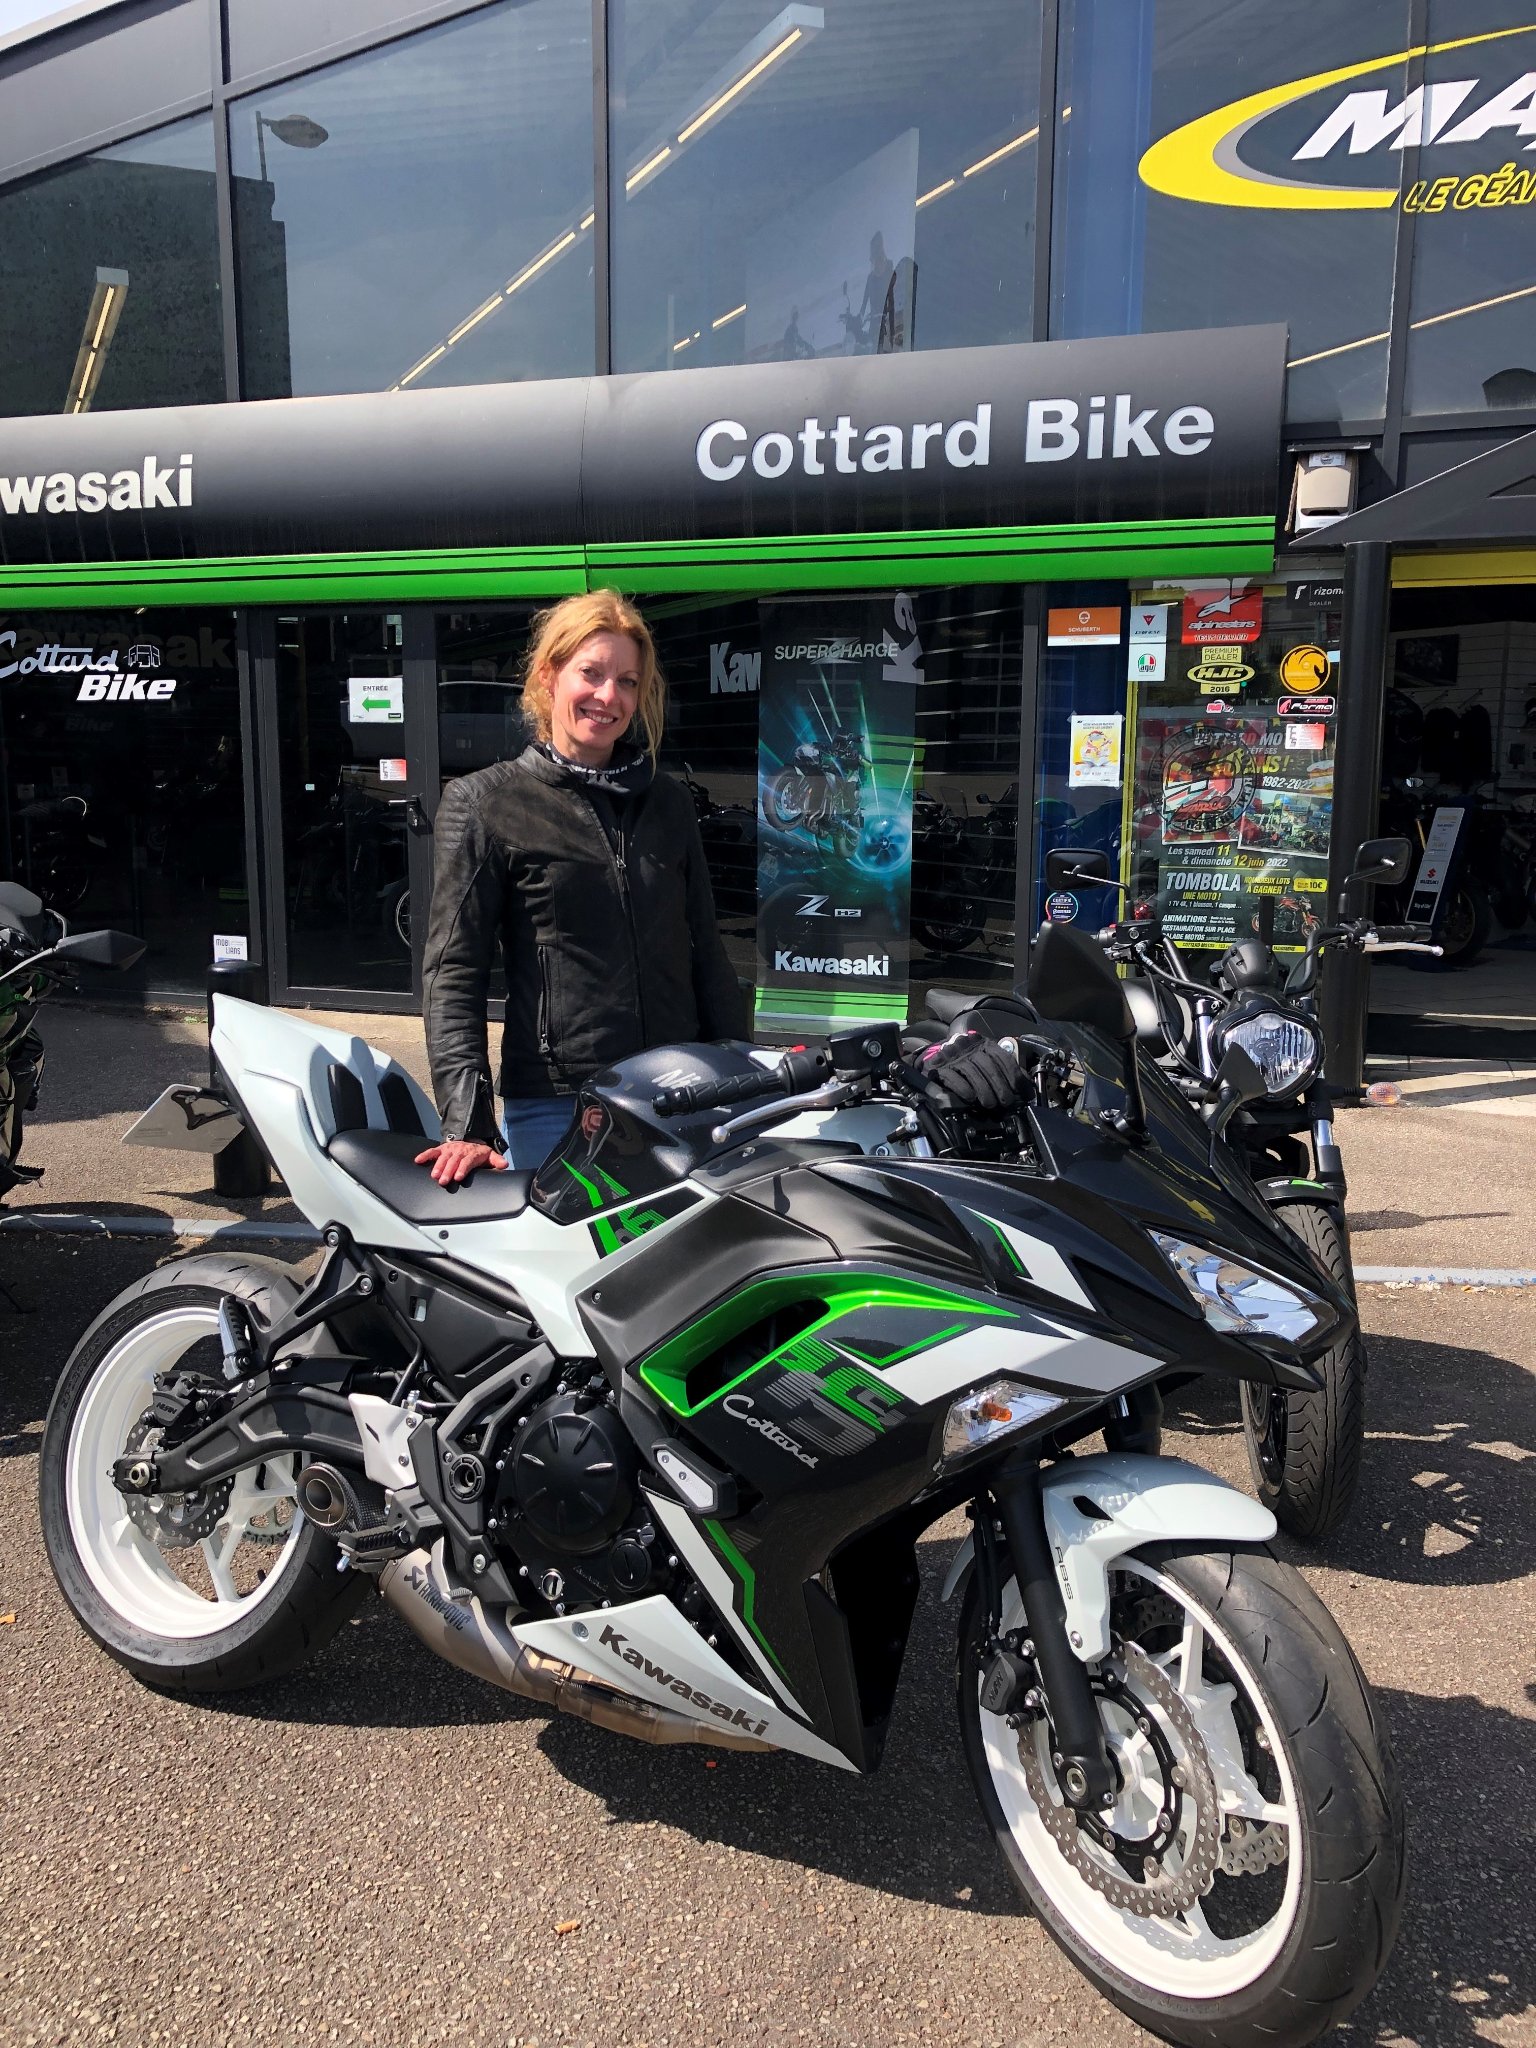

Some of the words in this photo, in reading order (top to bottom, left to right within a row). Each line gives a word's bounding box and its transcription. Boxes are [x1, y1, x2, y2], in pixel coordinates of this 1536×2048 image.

[1291, 71, 1536, 160] MA
[1403, 177, 1459, 214] LE
[696, 402, 992, 482] Cottard
[1025, 394, 1215, 463] Bike
[1313, 586, 1344, 596] rizom
[1188, 620, 1257, 631] alpinestars
[0, 631, 119, 678] Cottard
[774, 642, 900, 661] SUPERCHARGE
[1204, 653, 1238, 661] DEALER
[1196, 667, 1245, 679] HJC
[76, 673, 178, 701] Bike
[1262, 774, 1314, 791] 1982-2022
[1167, 846, 1184, 855] Les
[1184, 846, 1216, 856] samedi
[1217, 844, 1231, 856] 11
[1181, 855, 1189, 865] &
[1190, 856, 1232, 866] dimanche
[1233, 855, 1248, 867] 12
[1247, 858, 1265, 868] juin
[1266, 858, 1288, 867] 2022
[1166, 872, 1241, 892] TOMBOLA
[1253, 885, 1282, 895] GAGNER
[1196, 892, 1217, 901] MOTO
[1161, 914, 1208, 923] ANIMATIONS
[774, 950, 889, 976] Kawasaki
[723, 1393, 819, 1469] Cottard
[1055, 1546, 1074, 1600] ABS
[599, 1624, 770, 1738] Kawasaki
